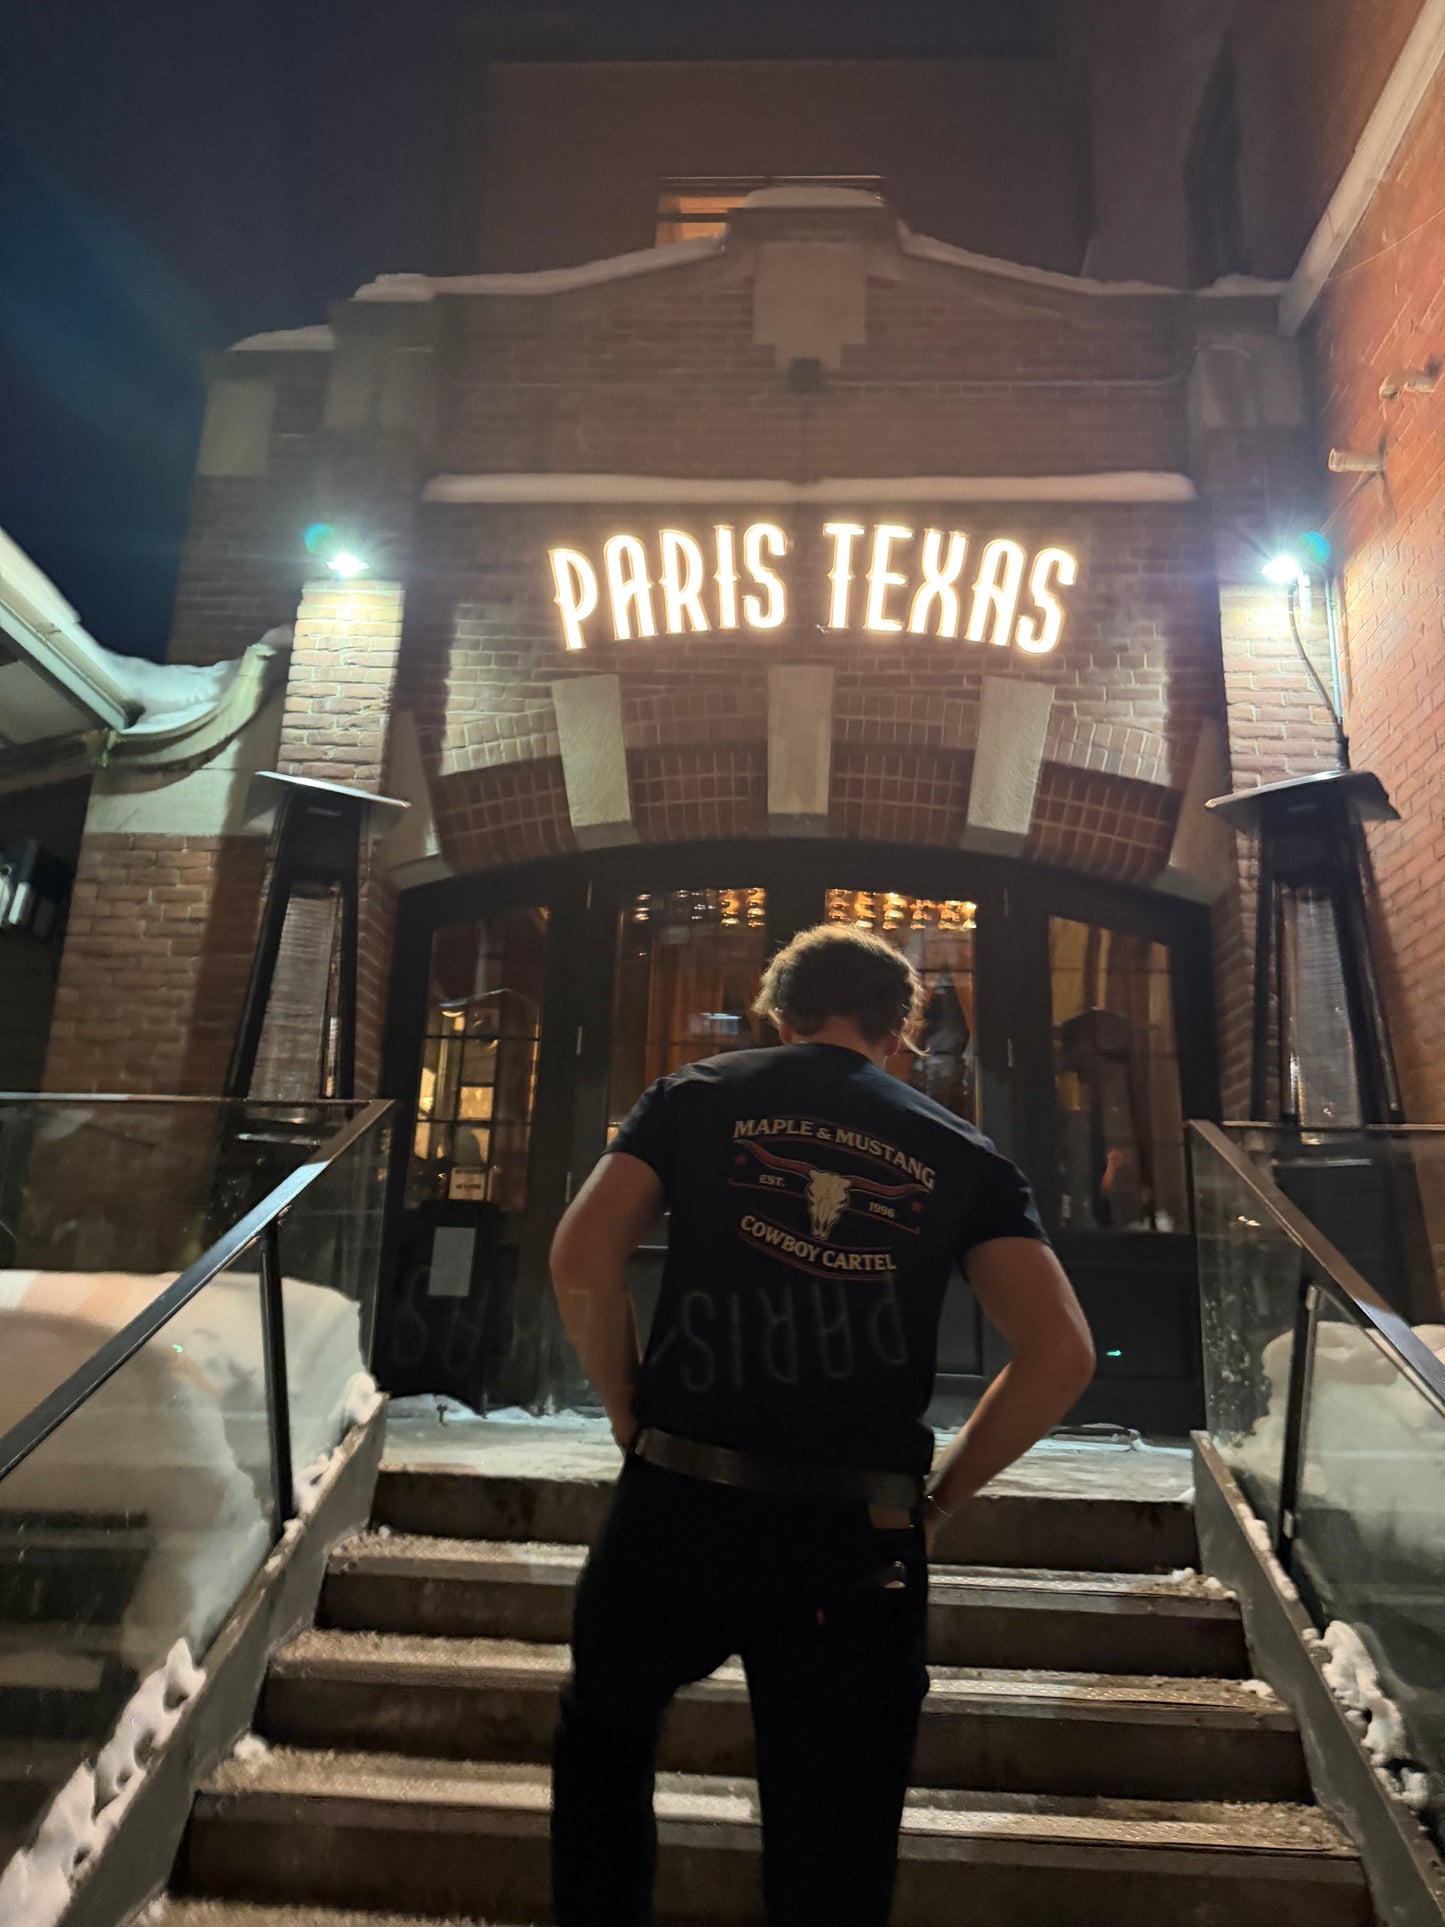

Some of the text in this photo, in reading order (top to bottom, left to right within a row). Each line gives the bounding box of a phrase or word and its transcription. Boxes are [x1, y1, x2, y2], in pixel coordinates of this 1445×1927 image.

[548, 522, 1078, 655] PARIS TEXAS
[733, 1118, 937, 1190] MAPLE & MUSTANG
[758, 1174, 785, 1187] EST.
[868, 1202, 896, 1219] 1996
[740, 1214, 897, 1272] COWBOY CARTEL
